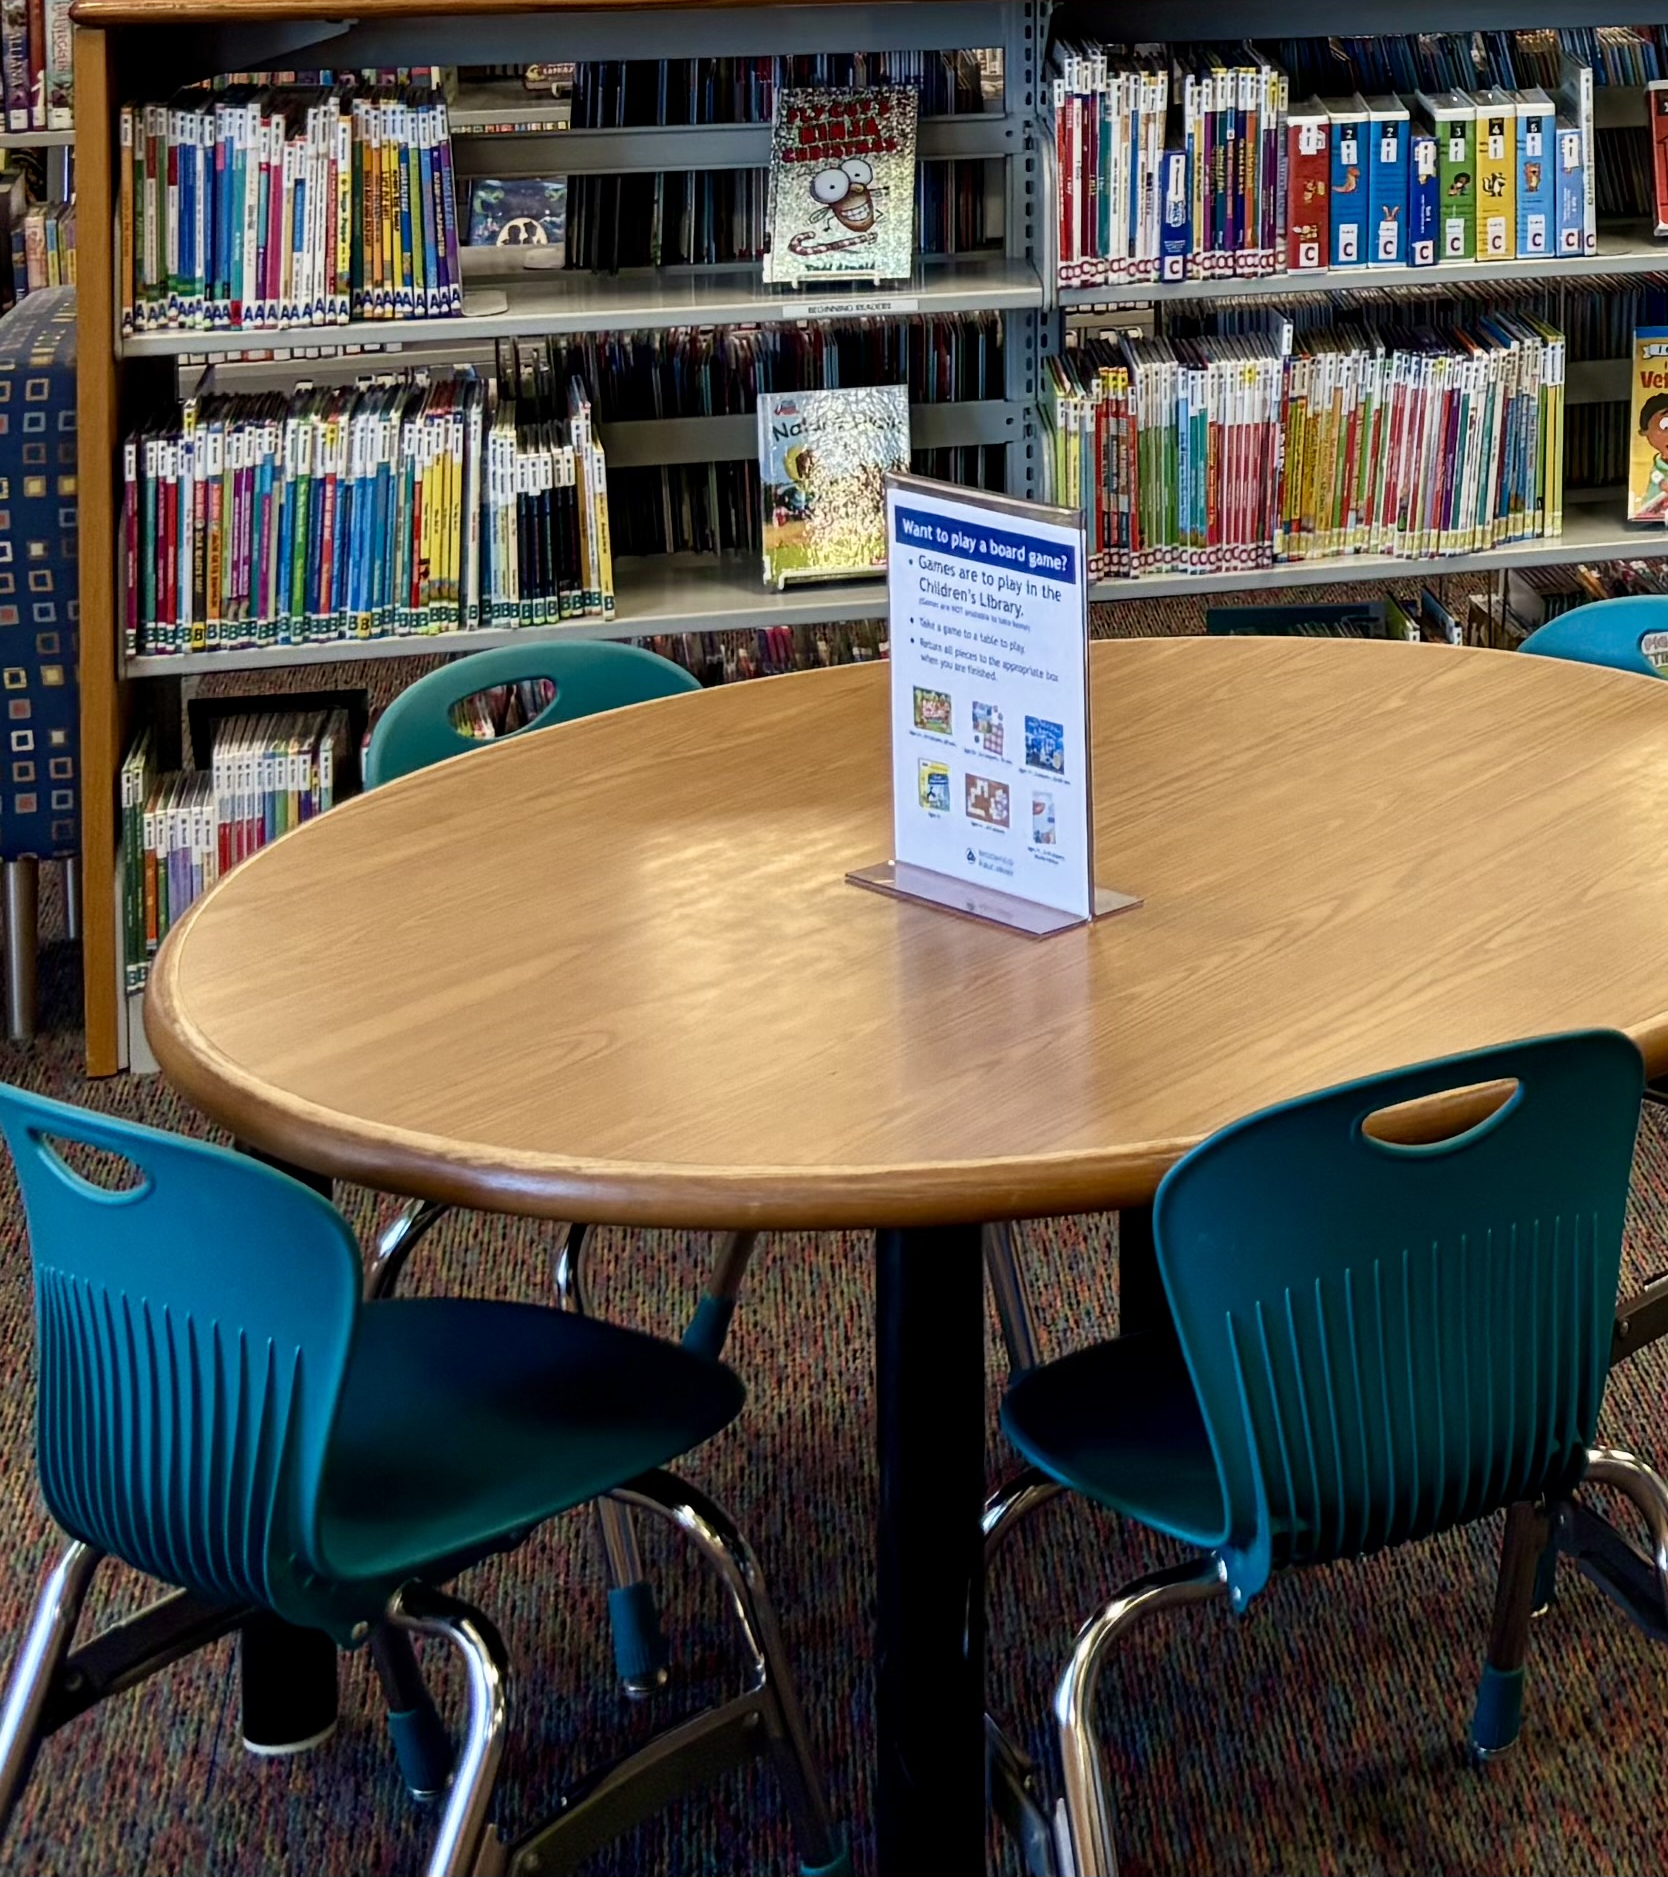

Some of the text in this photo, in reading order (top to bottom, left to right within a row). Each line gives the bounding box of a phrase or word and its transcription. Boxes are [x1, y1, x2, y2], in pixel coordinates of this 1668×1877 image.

[782, 136, 898, 163] CHRISTMAS
[800, 117, 881, 146] NINJA
[1304, 247, 1315, 261] C
[902, 518, 1068, 572] Want to play a board game?
[919, 555, 1062, 602] Games are to play in the
[919, 577, 976, 604] Children's
[980, 593, 1024, 620] Library.
